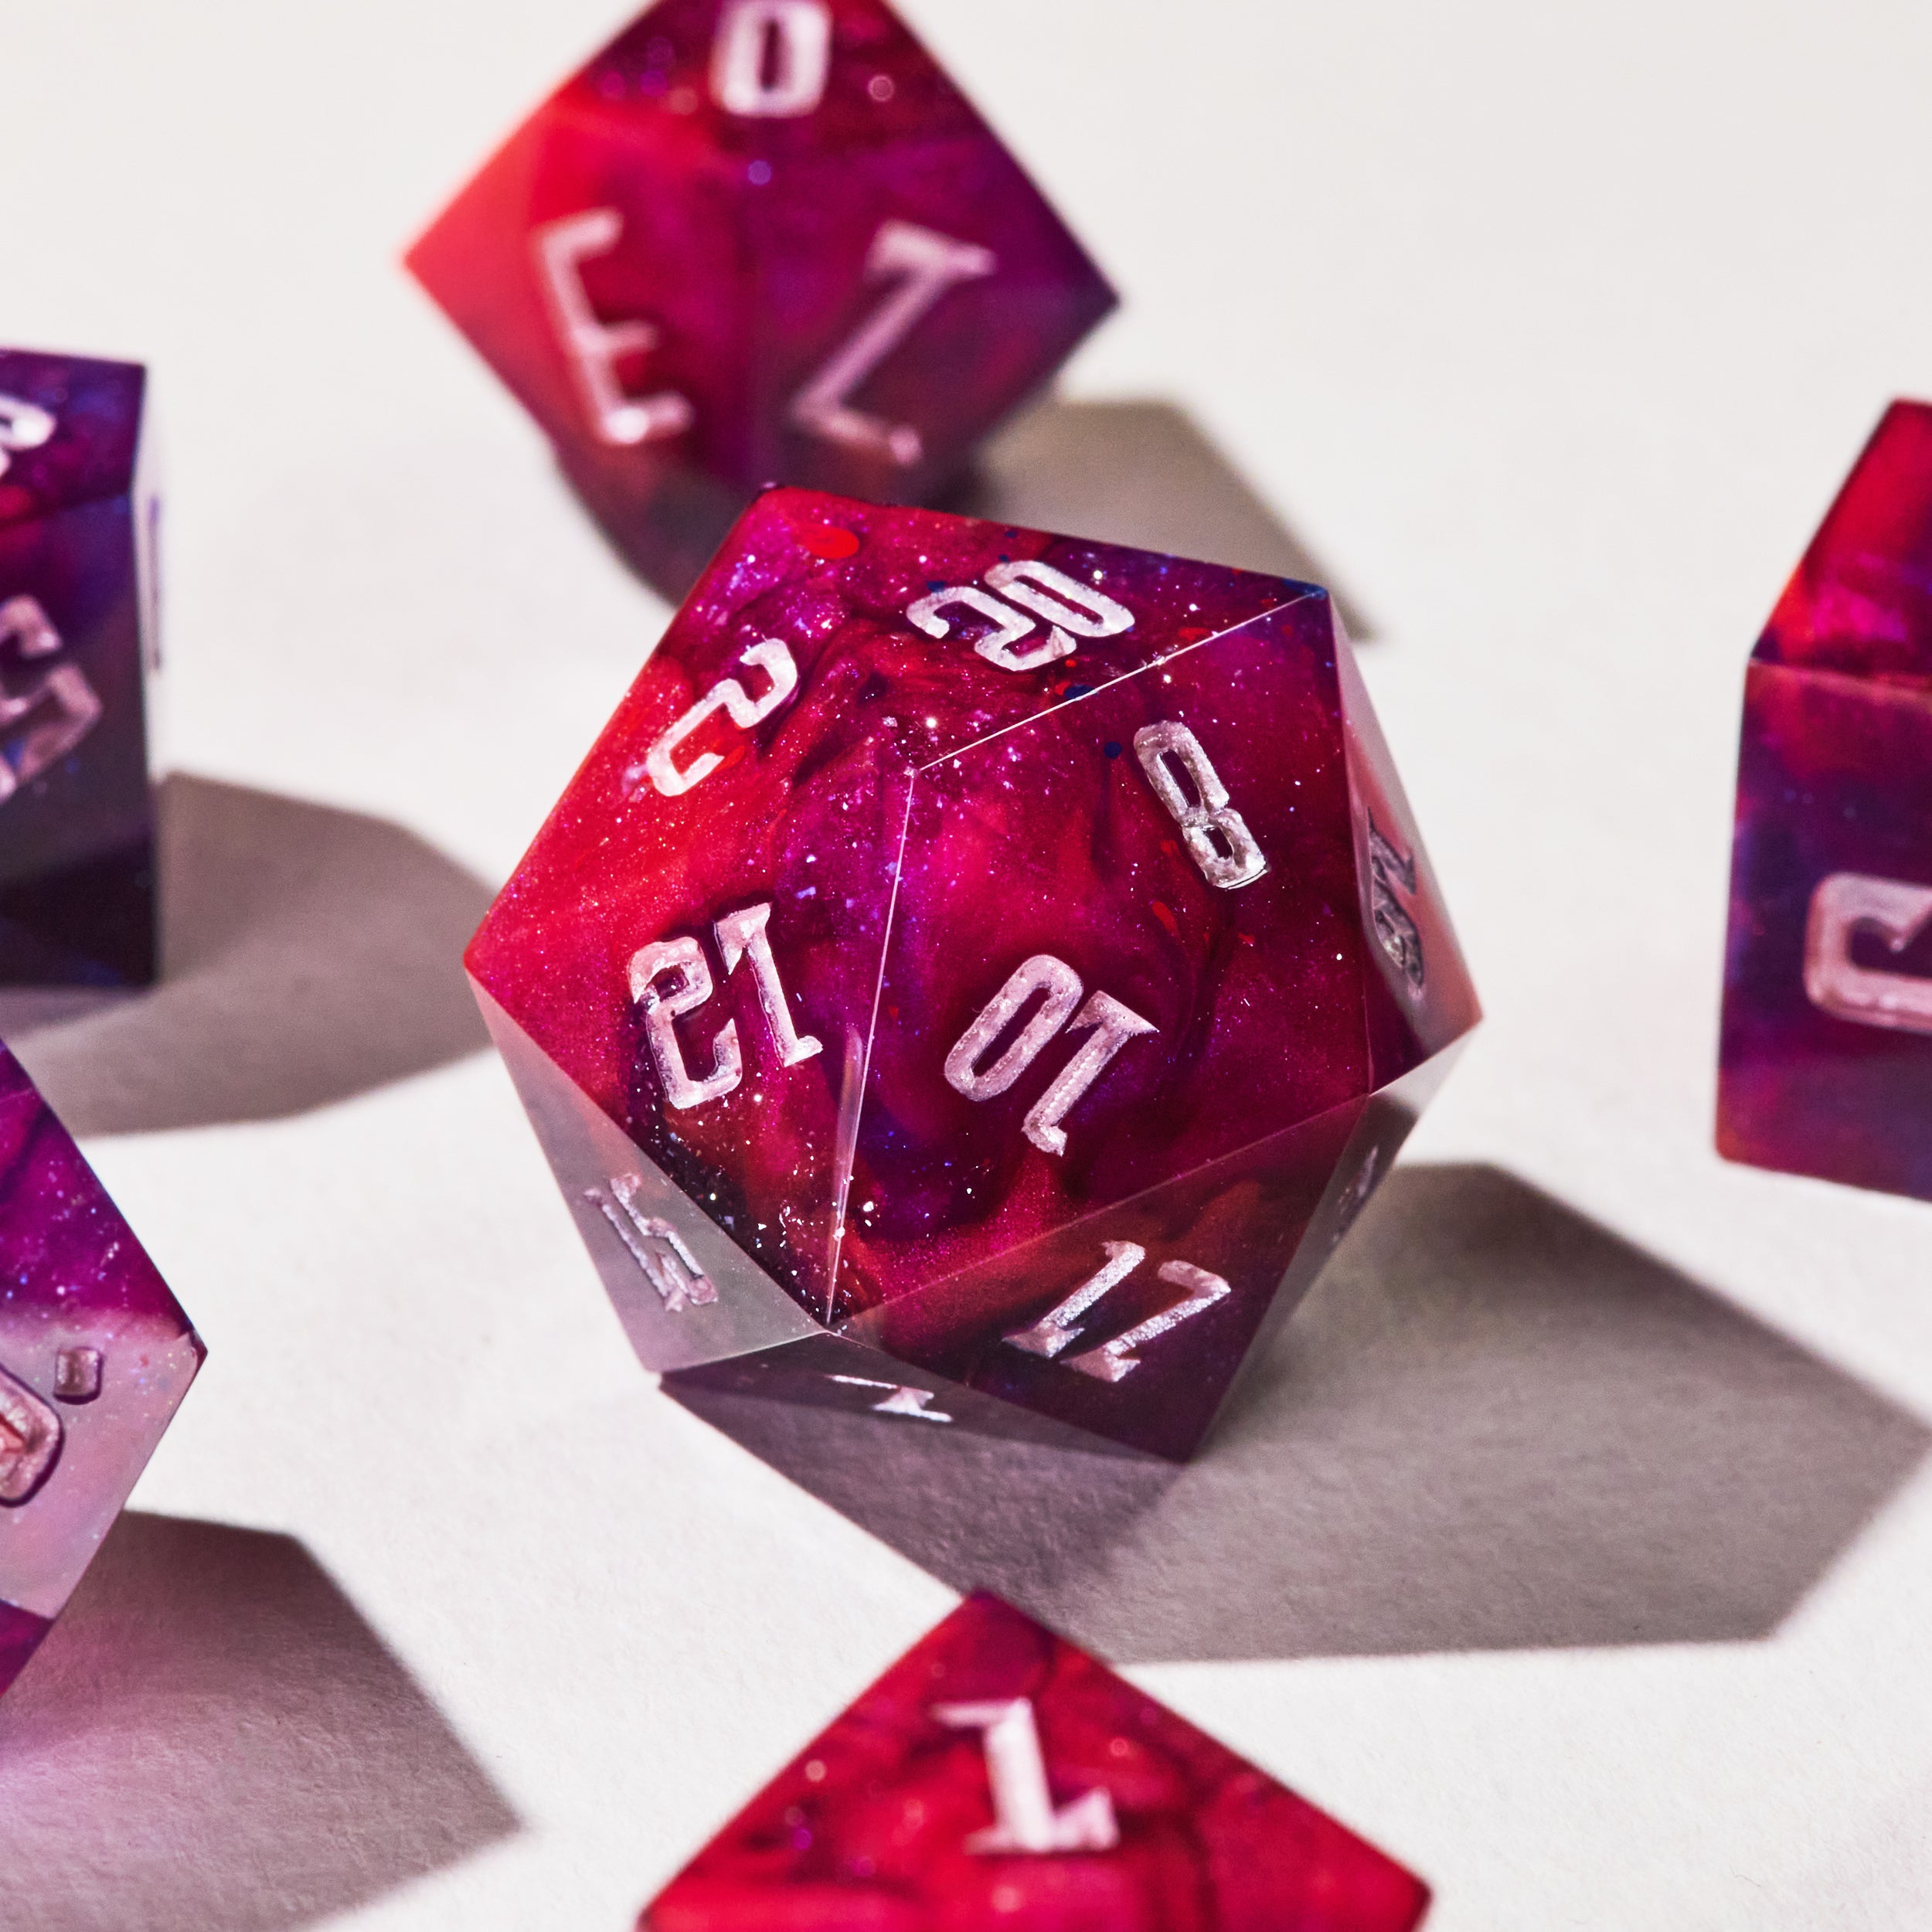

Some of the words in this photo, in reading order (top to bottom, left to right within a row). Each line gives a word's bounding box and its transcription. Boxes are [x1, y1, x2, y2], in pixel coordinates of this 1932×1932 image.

[906, 560, 1135, 672] 20
[645, 637, 799, 798] 2
[1133, 719, 1267, 890] 8
[626, 902, 824, 1110] 12
[944, 954, 1159, 1157] 10
[1002, 1240, 1232, 1383] 17
